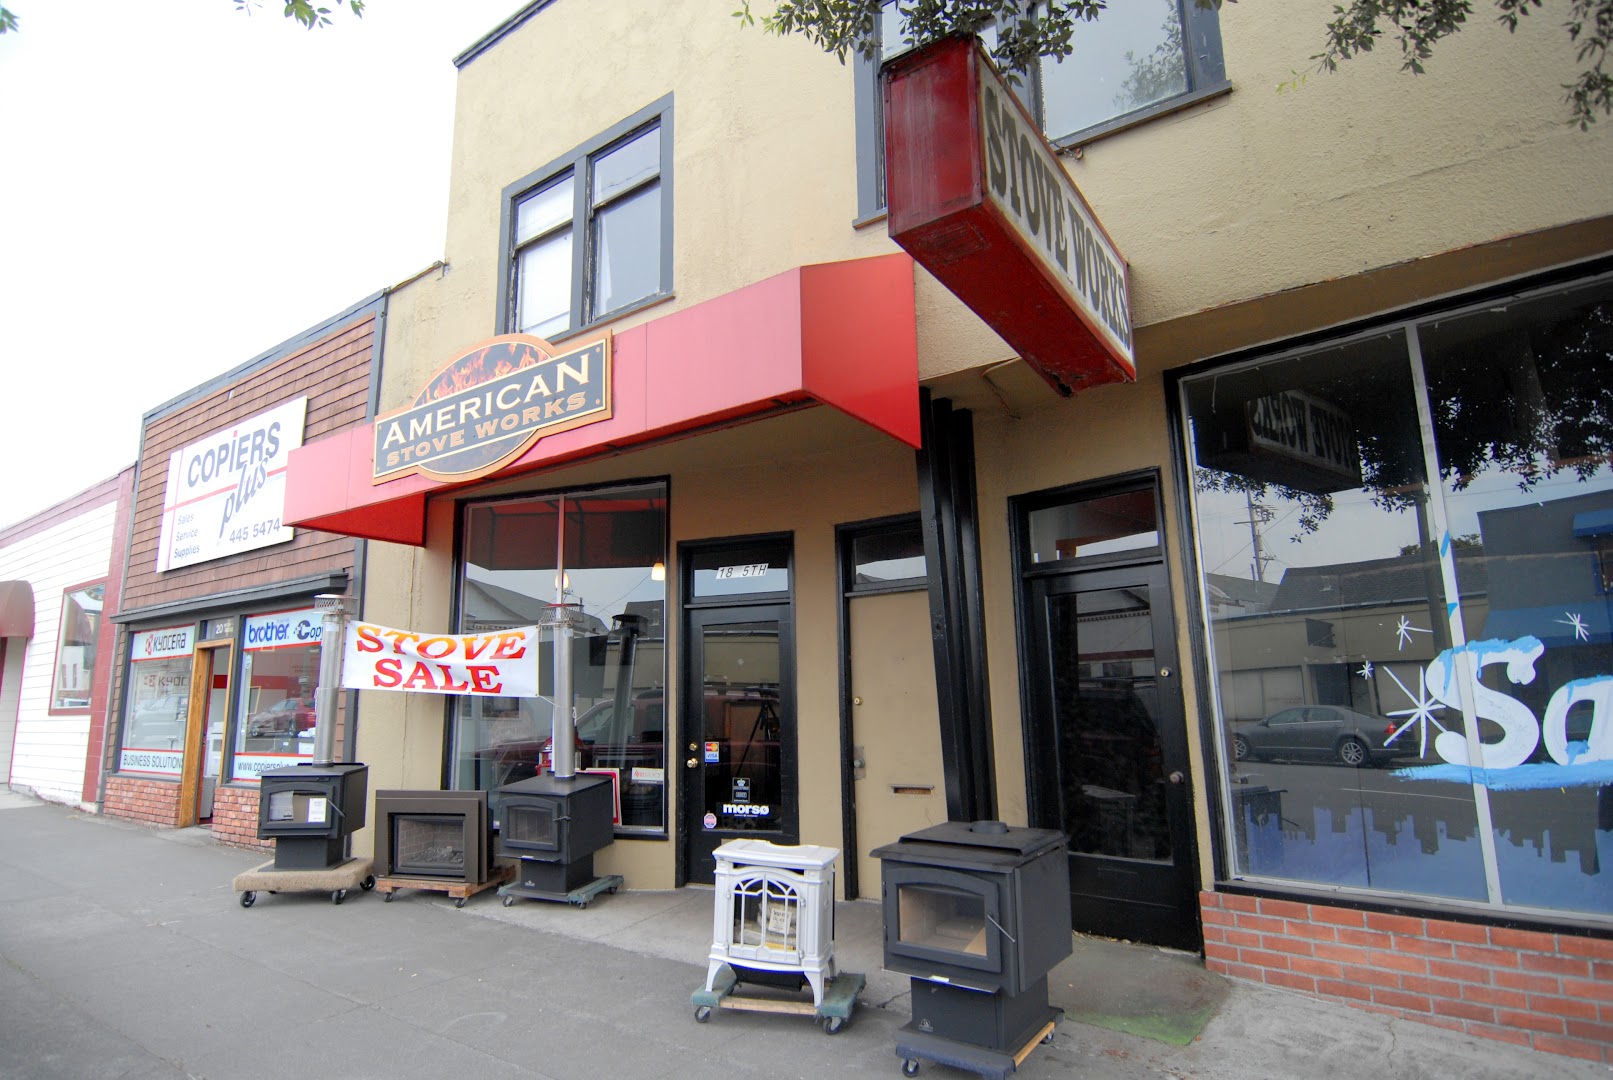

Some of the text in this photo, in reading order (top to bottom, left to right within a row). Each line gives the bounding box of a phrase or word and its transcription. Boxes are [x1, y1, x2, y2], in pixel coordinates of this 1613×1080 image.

[985, 86, 1131, 351] STOVE WORKS
[382, 352, 590, 450] AMERICAN
[386, 391, 586, 467] STOVE WORKS
[187, 421, 281, 488] COPIERS
[219, 457, 269, 539] plus
[177, 513, 194, 526] Sales
[229, 518, 281, 544] 445 5474
[175, 528, 199, 542] Service
[174, 544, 200, 559] Supplies
[720, 564, 767, 578] 18 5TH
[153, 632, 187, 653] KYOCERA
[248, 621, 290, 643] brother
[357, 625, 527, 660] STOVE
[373, 658, 503, 694] SALE
[123, 754, 151, 767] BUSINESS
[722, 803, 770, 815] morsø
